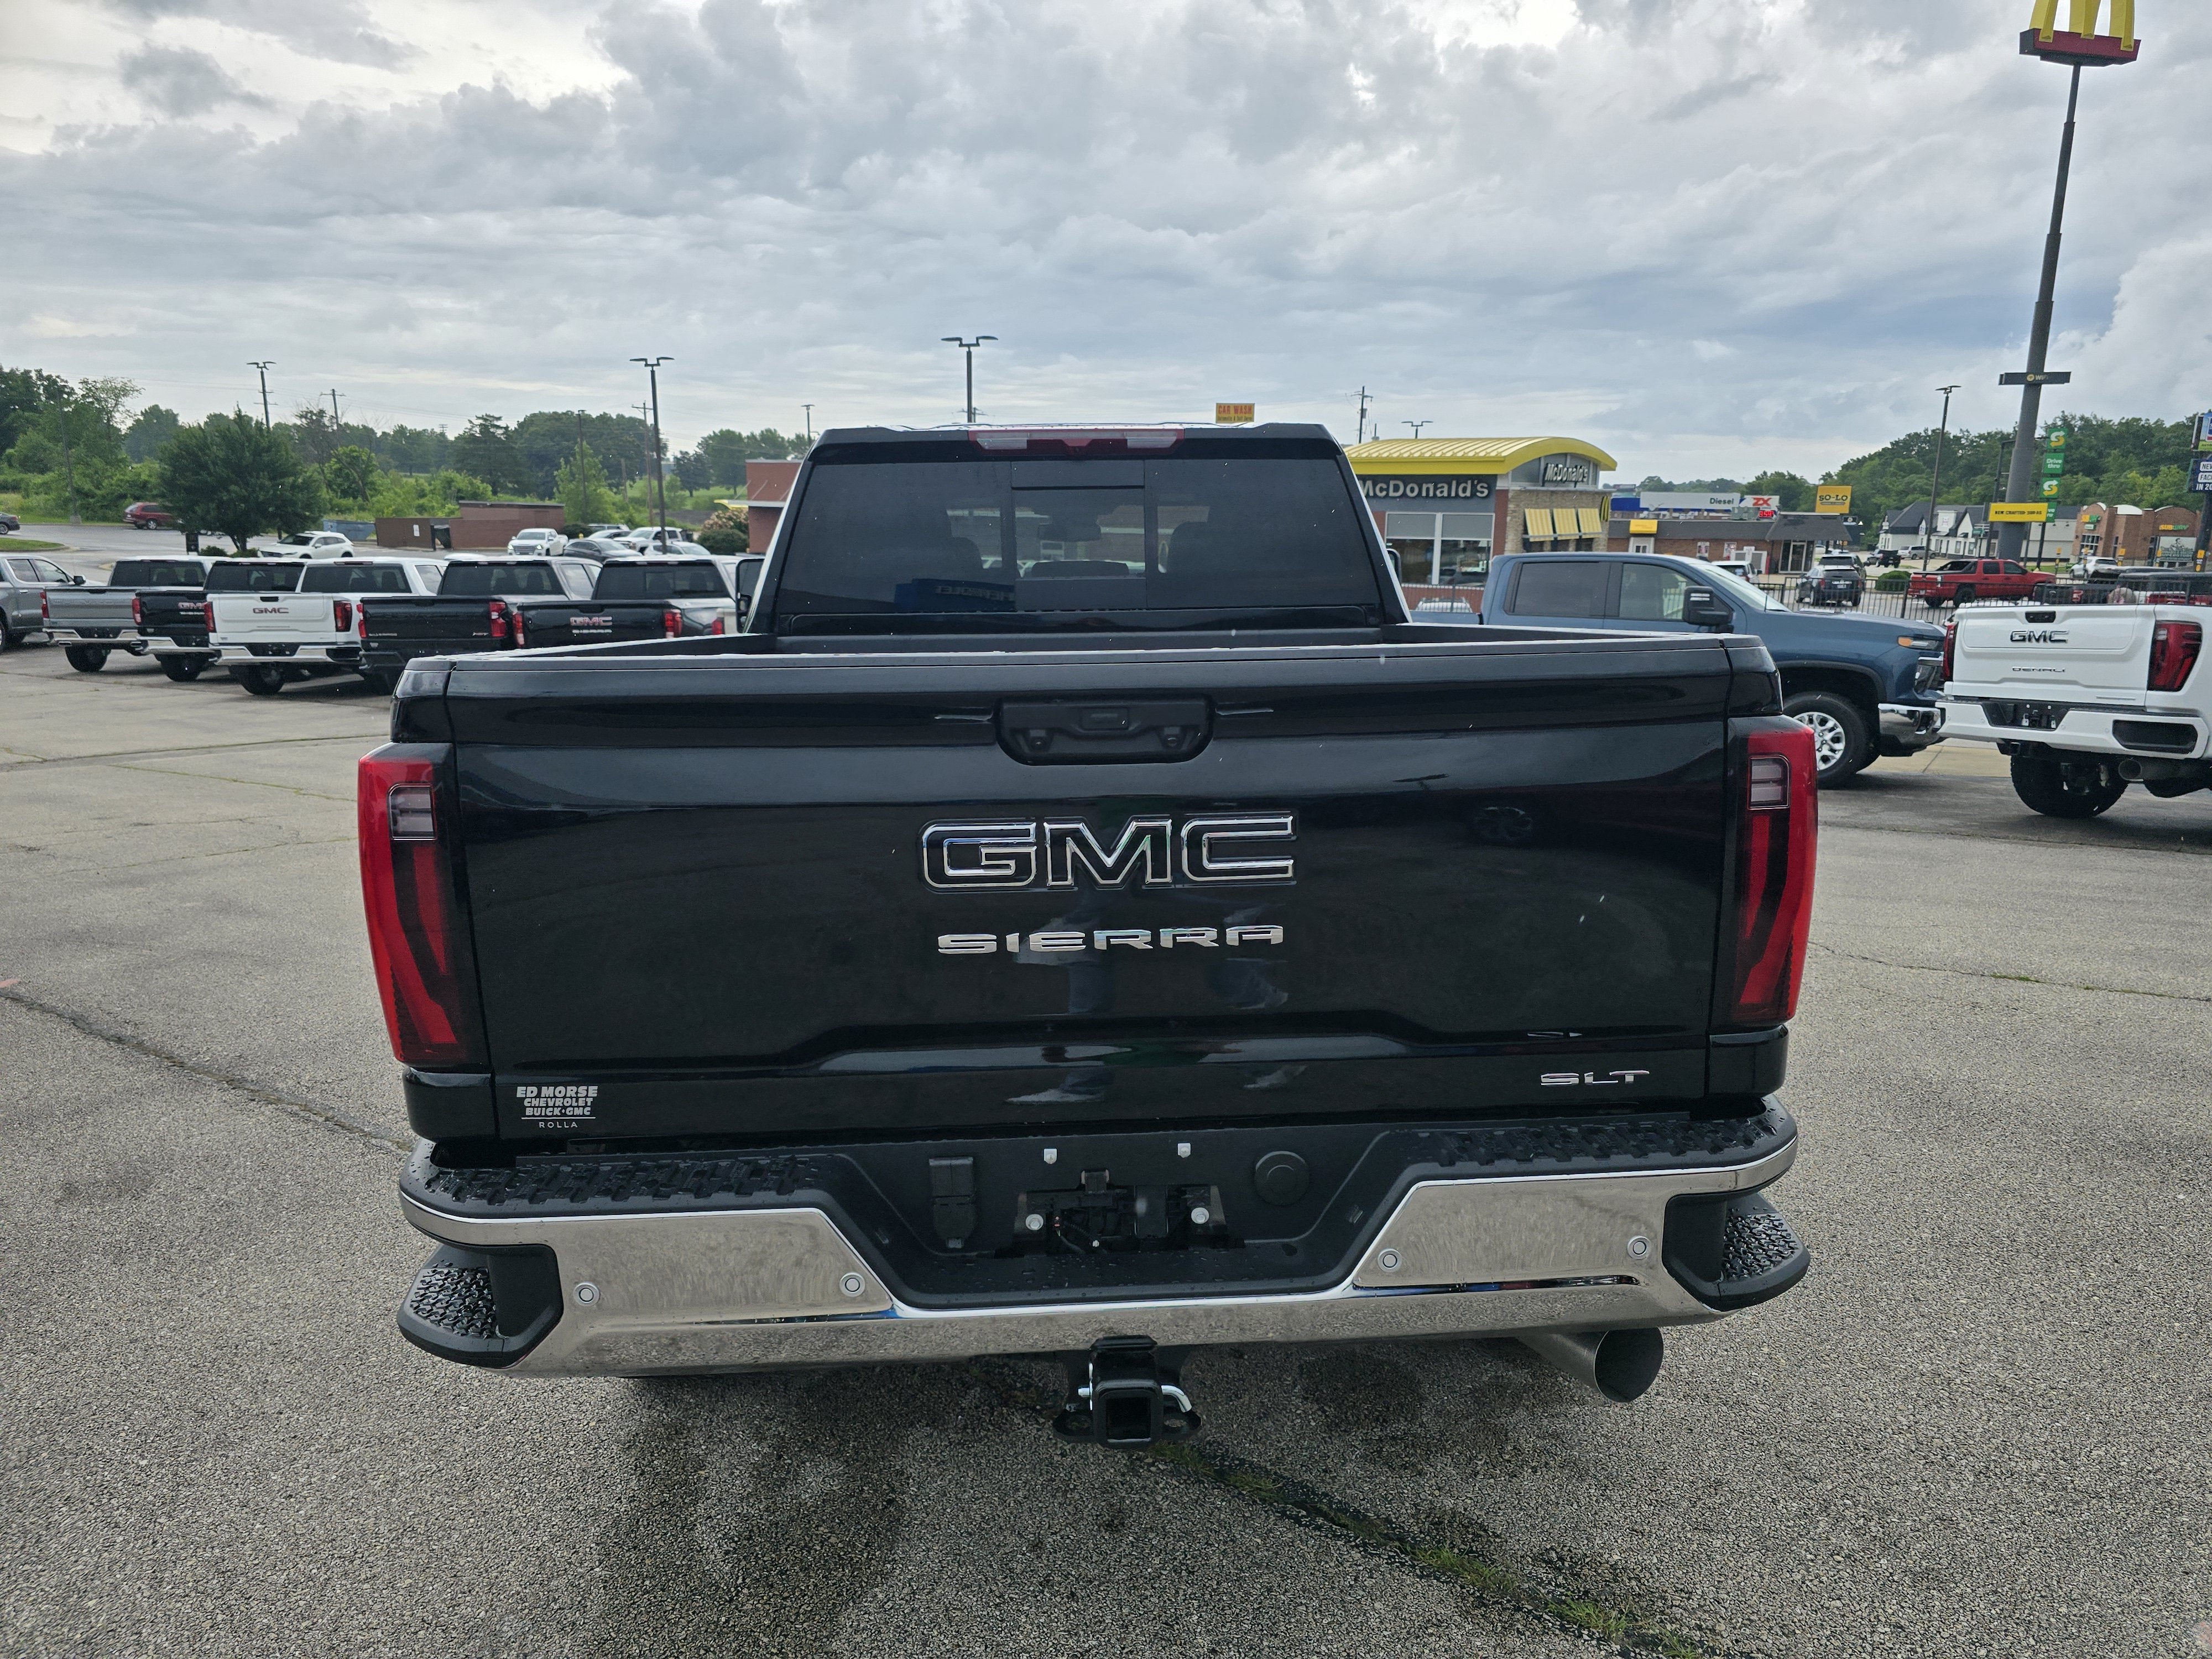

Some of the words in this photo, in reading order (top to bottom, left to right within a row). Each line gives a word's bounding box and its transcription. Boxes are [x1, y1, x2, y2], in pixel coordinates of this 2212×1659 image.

[1218, 405, 1230, 415] CAR
[1234, 405, 1252, 415] WASH
[1545, 463, 1588, 482] McDonald's
[1358, 479, 1488, 497] McDonald's
[1752, 497, 1772, 507] ZX
[570, 617, 612, 626] GMC
[2010, 630, 2069, 644] GMC
[920, 814, 1296, 891] GMC
[937, 925, 1284, 955] SIERRA
[1540, 1070, 1650, 1086] SLT
[517, 1086, 538, 1098] ED
[541, 1086, 598, 1097] MORSE
[524, 1098, 593, 1107] CHEVROLET
